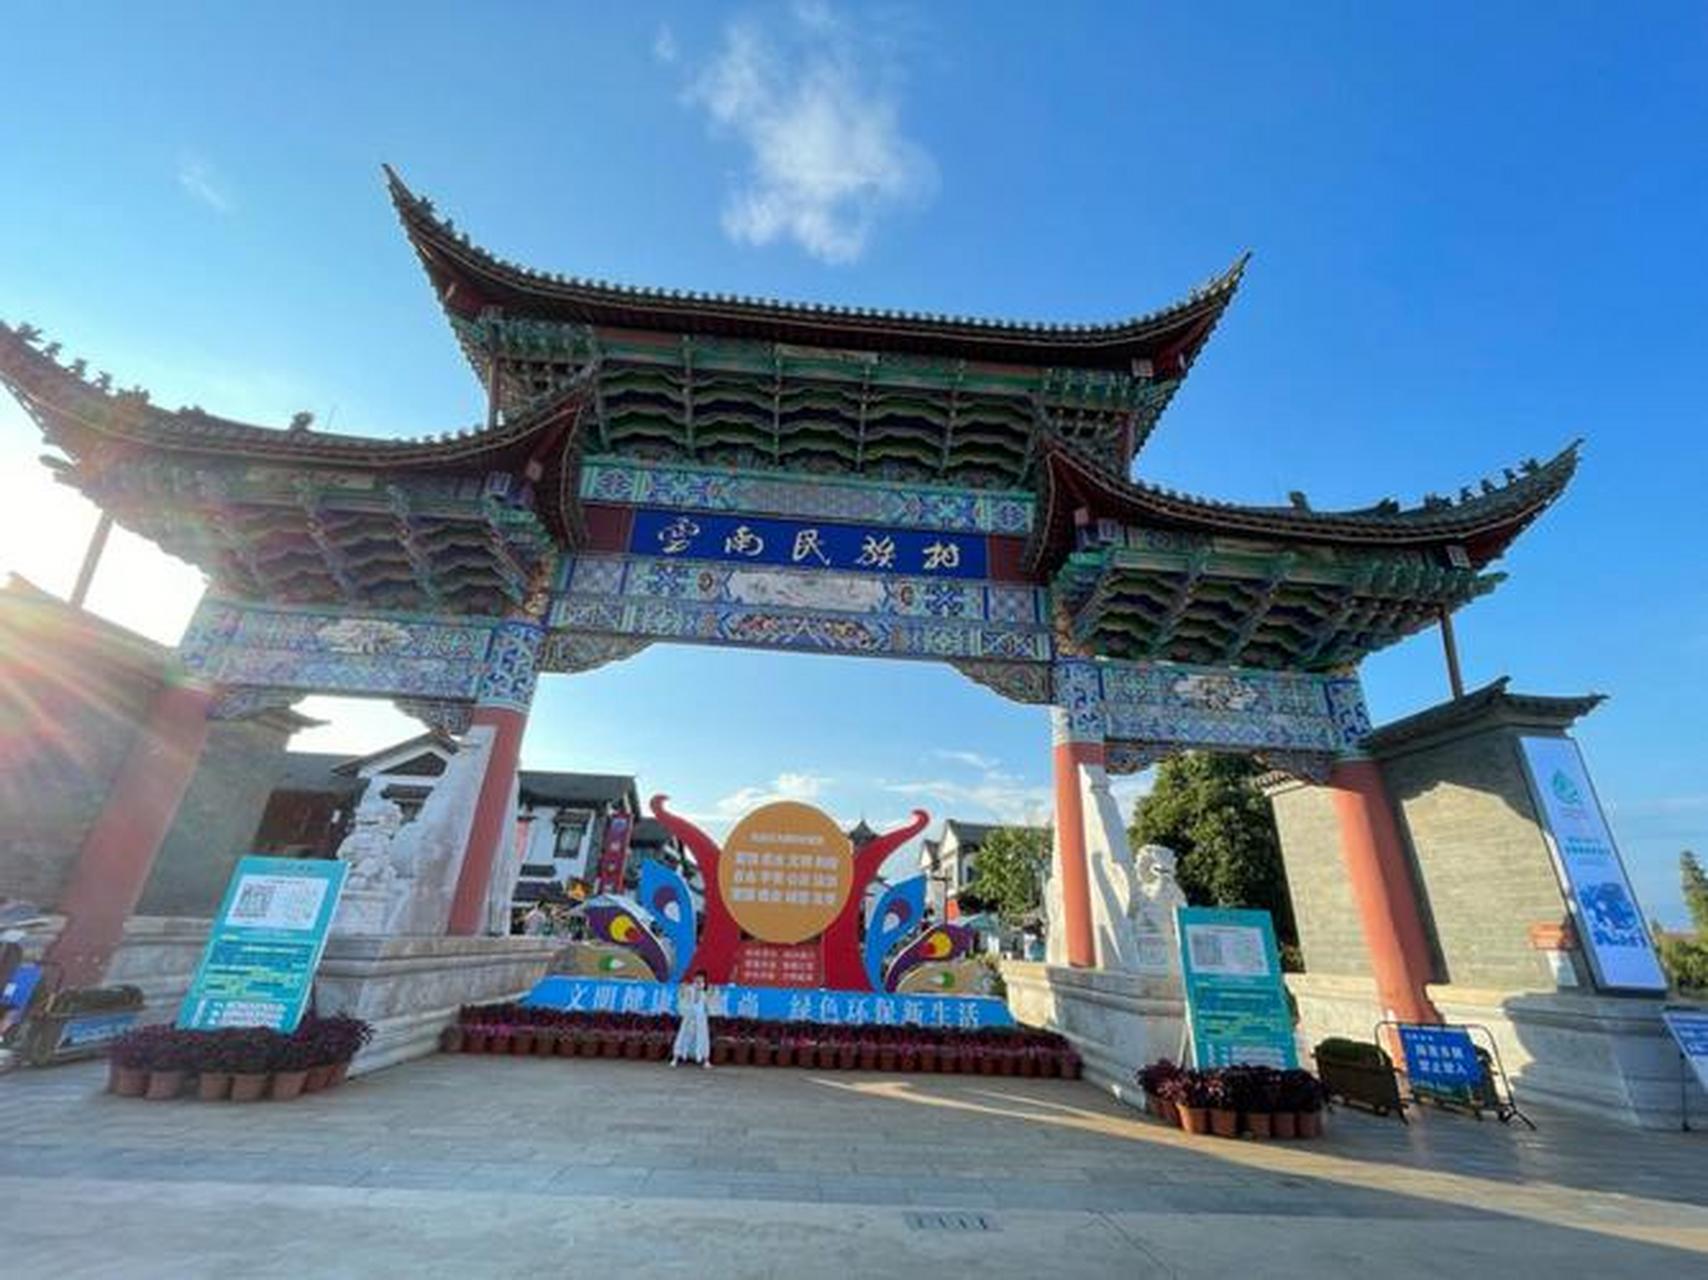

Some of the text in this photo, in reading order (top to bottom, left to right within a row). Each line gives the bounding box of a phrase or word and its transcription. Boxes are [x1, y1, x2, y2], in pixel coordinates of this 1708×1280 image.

[566, 983, 759, 1018] 文明健康尚
